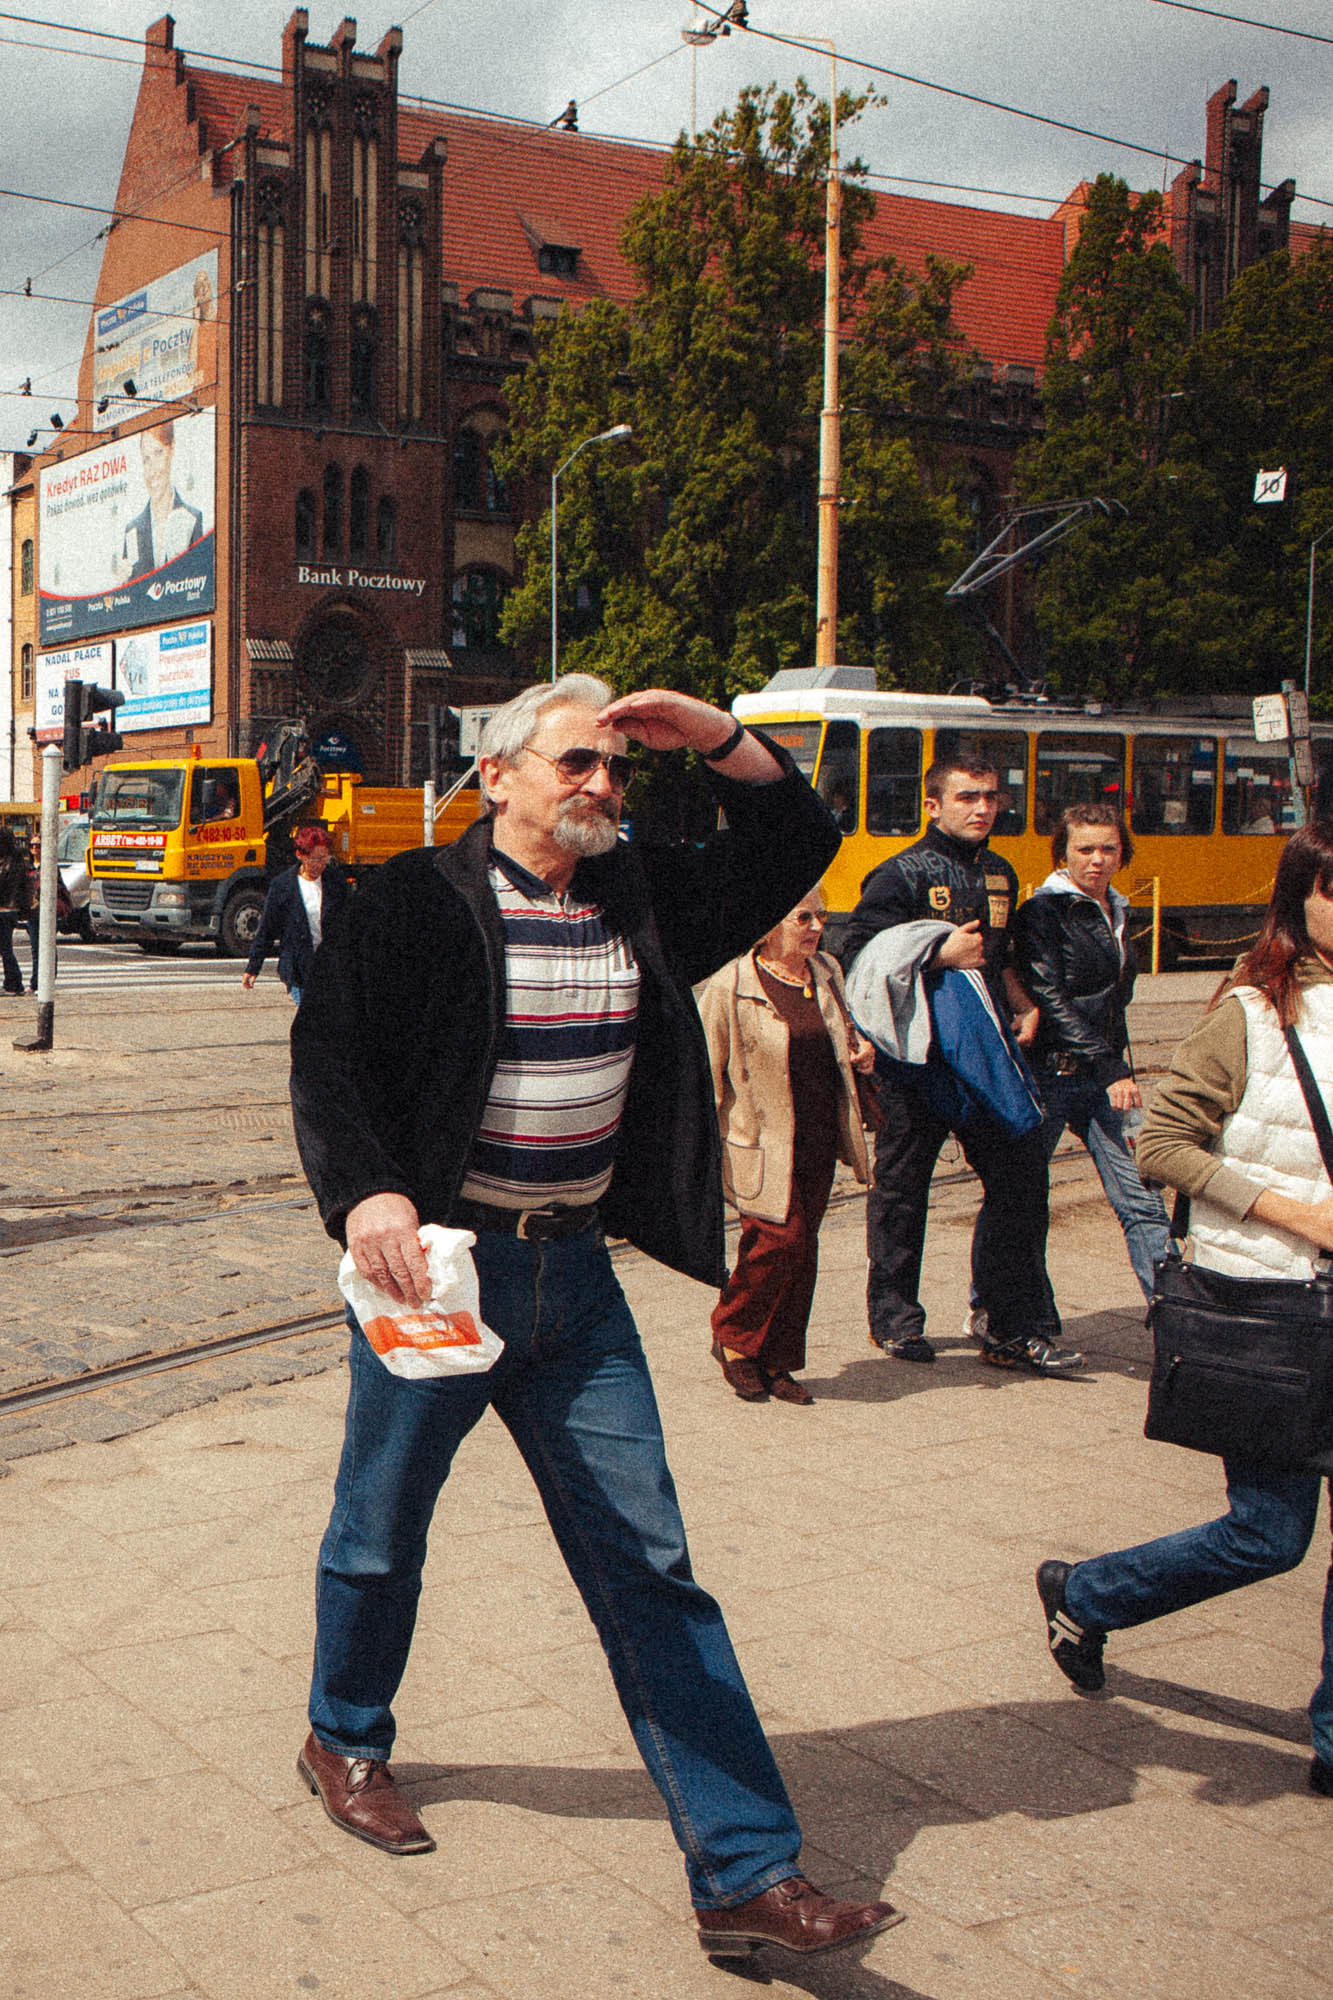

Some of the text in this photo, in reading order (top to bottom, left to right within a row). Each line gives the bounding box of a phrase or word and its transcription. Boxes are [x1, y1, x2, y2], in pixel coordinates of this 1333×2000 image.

[152, 326, 194, 357] Poczty
[47, 455, 128, 496] Kredyt RAZ DWA
[1261, 479, 1280, 494] 10
[164, 575, 207, 596] Pocztowy
[298, 566, 426, 597] Bank Pocztowy
[45, 646, 102, 666] NADAL PŁACĘ
[64, 667, 81, 681] ZUS
[48, 687, 59, 698] NA
[935, 889, 949, 906] 5
